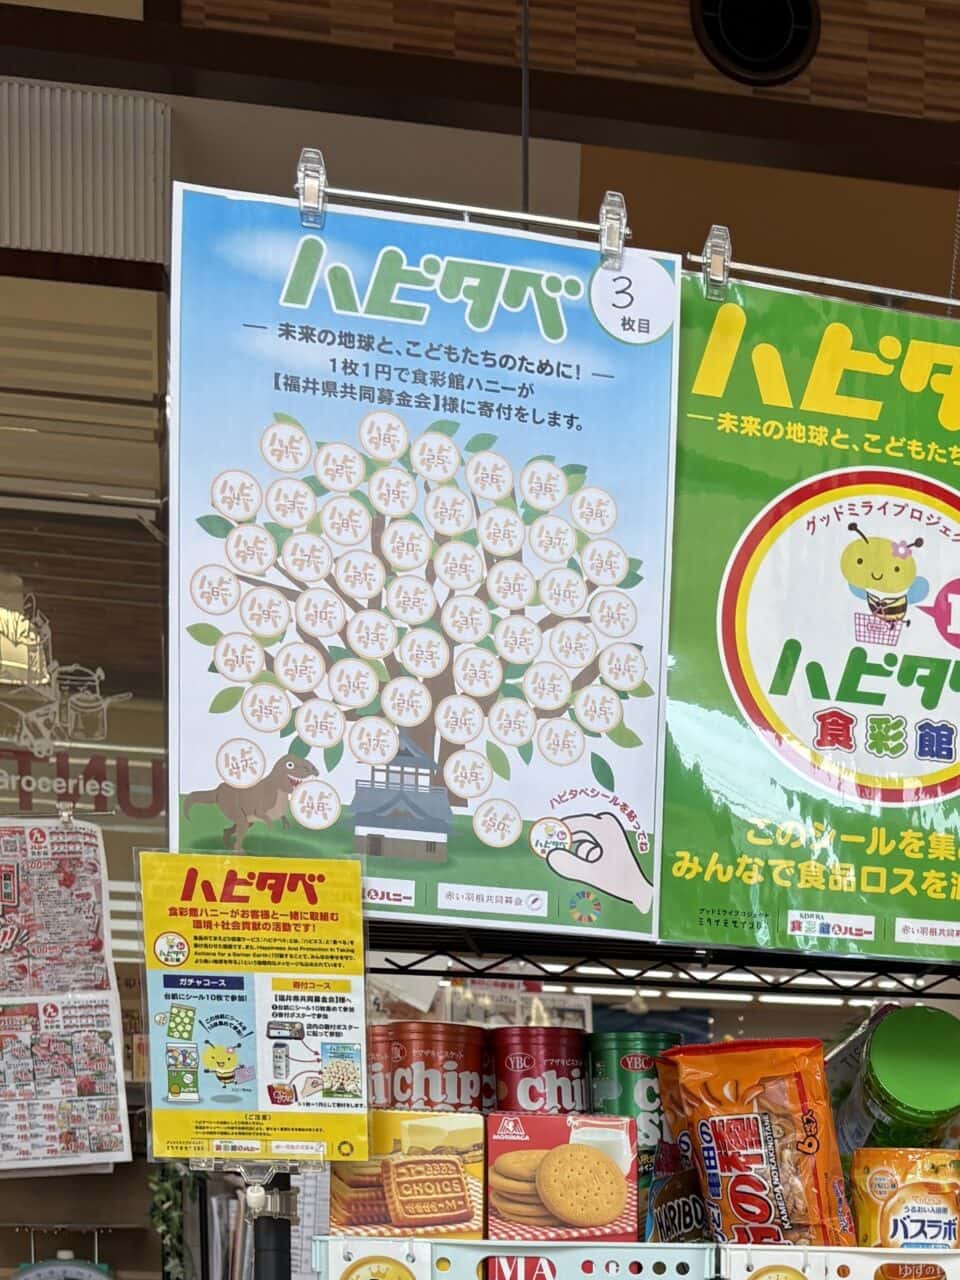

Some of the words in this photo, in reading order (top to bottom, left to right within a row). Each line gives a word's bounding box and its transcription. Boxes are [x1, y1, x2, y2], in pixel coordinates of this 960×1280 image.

[621, 315, 652, 335] 枚目
[327, 356, 535, 399] 1枚1円で食彩館ハニーが
[812, 707, 958, 763] 食彩館
[181, 867, 325, 905] ハピタベ
[178, 977, 227, 988] ガチャコース
[508, 1056, 533, 1069] YBC
[623, 1056, 651, 1069] YBC
[517, 1068, 588, 1111] chi
[400, 1178, 462, 1197] CHOICE
[655, 1194, 705, 1242] HARIBO
[890, 1215, 960, 1241] バスラボ
